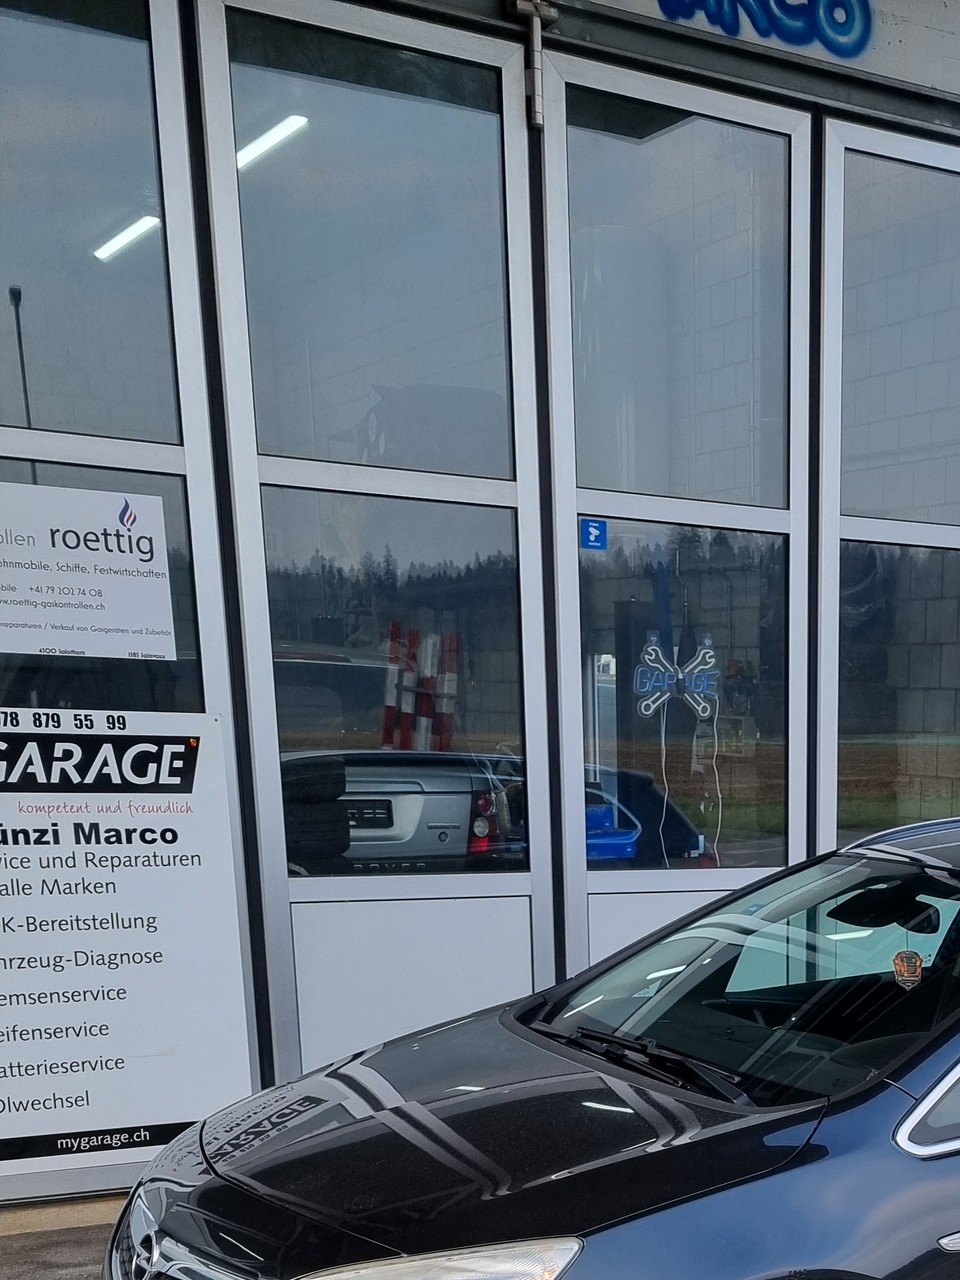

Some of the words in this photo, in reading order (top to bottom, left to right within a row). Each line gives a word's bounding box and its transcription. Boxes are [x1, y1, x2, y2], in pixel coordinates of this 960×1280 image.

[50, 527, 154, 562] roettig
[56, 561, 91, 575] Schiffe,
[94, 565, 167, 579] Festwirtschaften
[0, 584, 17, 593] bile
[28, 585, 43, 594] +41
[45, 585, 55, 595] 79
[58, 586, 75, 597] 202
[77, 588, 87, 597] 74
[88, 588, 103, 598] 08
[50, 622, 75, 632] Verkauf
[131, 627, 143, 635] und
[39, 647, 57, 655] 4500
[0, 711, 20, 728] 78
[32, 712, 62, 729] 879
[73, 713, 95, 730] 55
[106, 714, 127, 731] 99
[0, 741, 186, 785] ARAGE
[18, 801, 91, 819] kompetent
[97, 800, 123, 815] und
[128, 800, 194, 819] freundlich
[73, 822, 179, 846] Marco
[0, 852, 31, 870] ice
[39, 851, 77, 870] und
[84, 851, 202, 873] Reparaturen
[0, 878, 33, 897] alle
[40, 877, 117, 897] Marken
[2, 912, 158, 934] K-Bereitstellung
[57, 1128, 150, 1151] mygarage.ch
